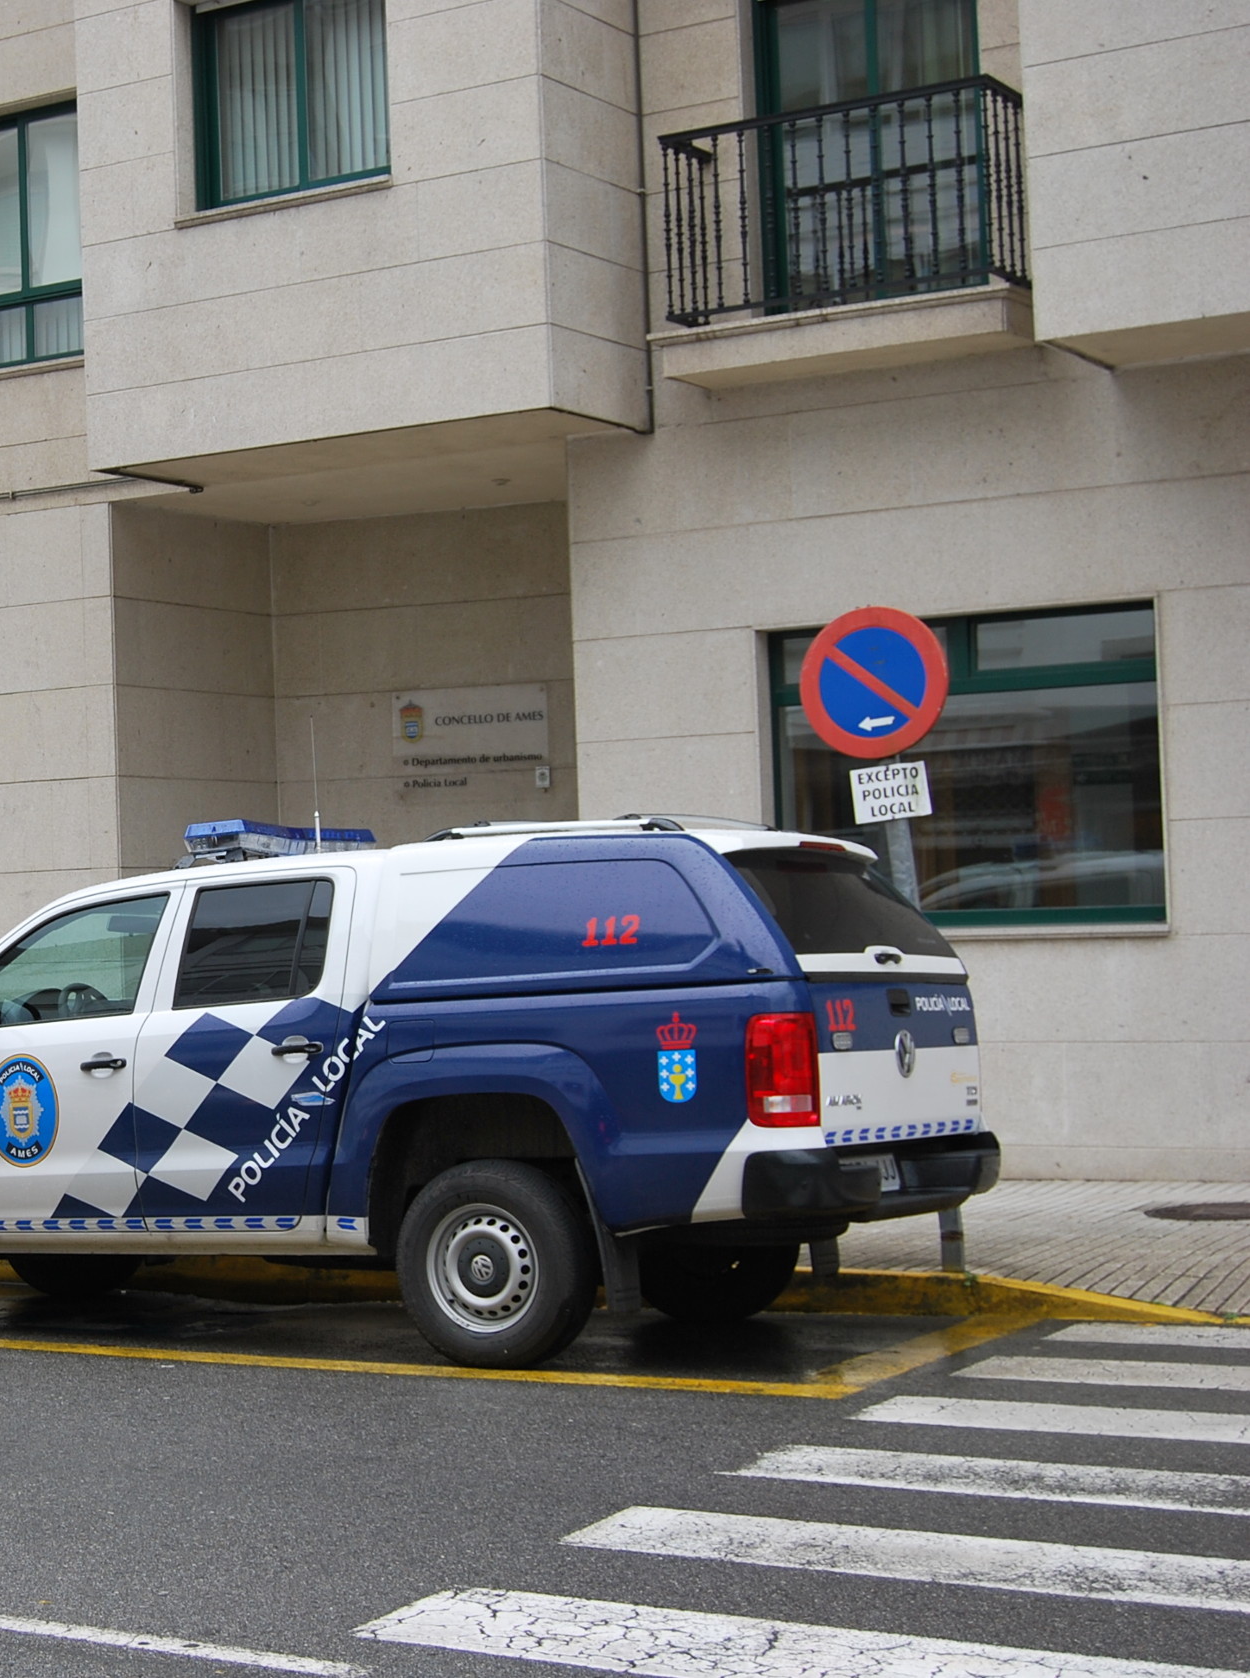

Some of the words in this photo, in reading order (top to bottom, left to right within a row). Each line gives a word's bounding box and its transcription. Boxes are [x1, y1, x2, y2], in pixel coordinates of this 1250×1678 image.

[434, 713, 494, 726] CONCELLO
[497, 712, 511, 723] DE
[515, 710, 544, 722] AMES
[411, 756, 477, 768] Departamento
[479, 754, 491, 763] de
[493, 753, 542, 762] urbanismo
[444, 776, 467, 787] Local
[857, 766, 919, 785] EXCEPTO
[862, 784, 919, 801] POLICIA
[871, 801, 915, 817] LOCAL
[582, 914, 640, 947] 112
[825, 998, 857, 1031] 112
[23, 1065, 40, 1081] LOCAL
[227, 1107, 310, 1203] POLICÍA
[312, 1015, 386, 1093] LOCAL
[10, 1146, 38, 1158] AMES
